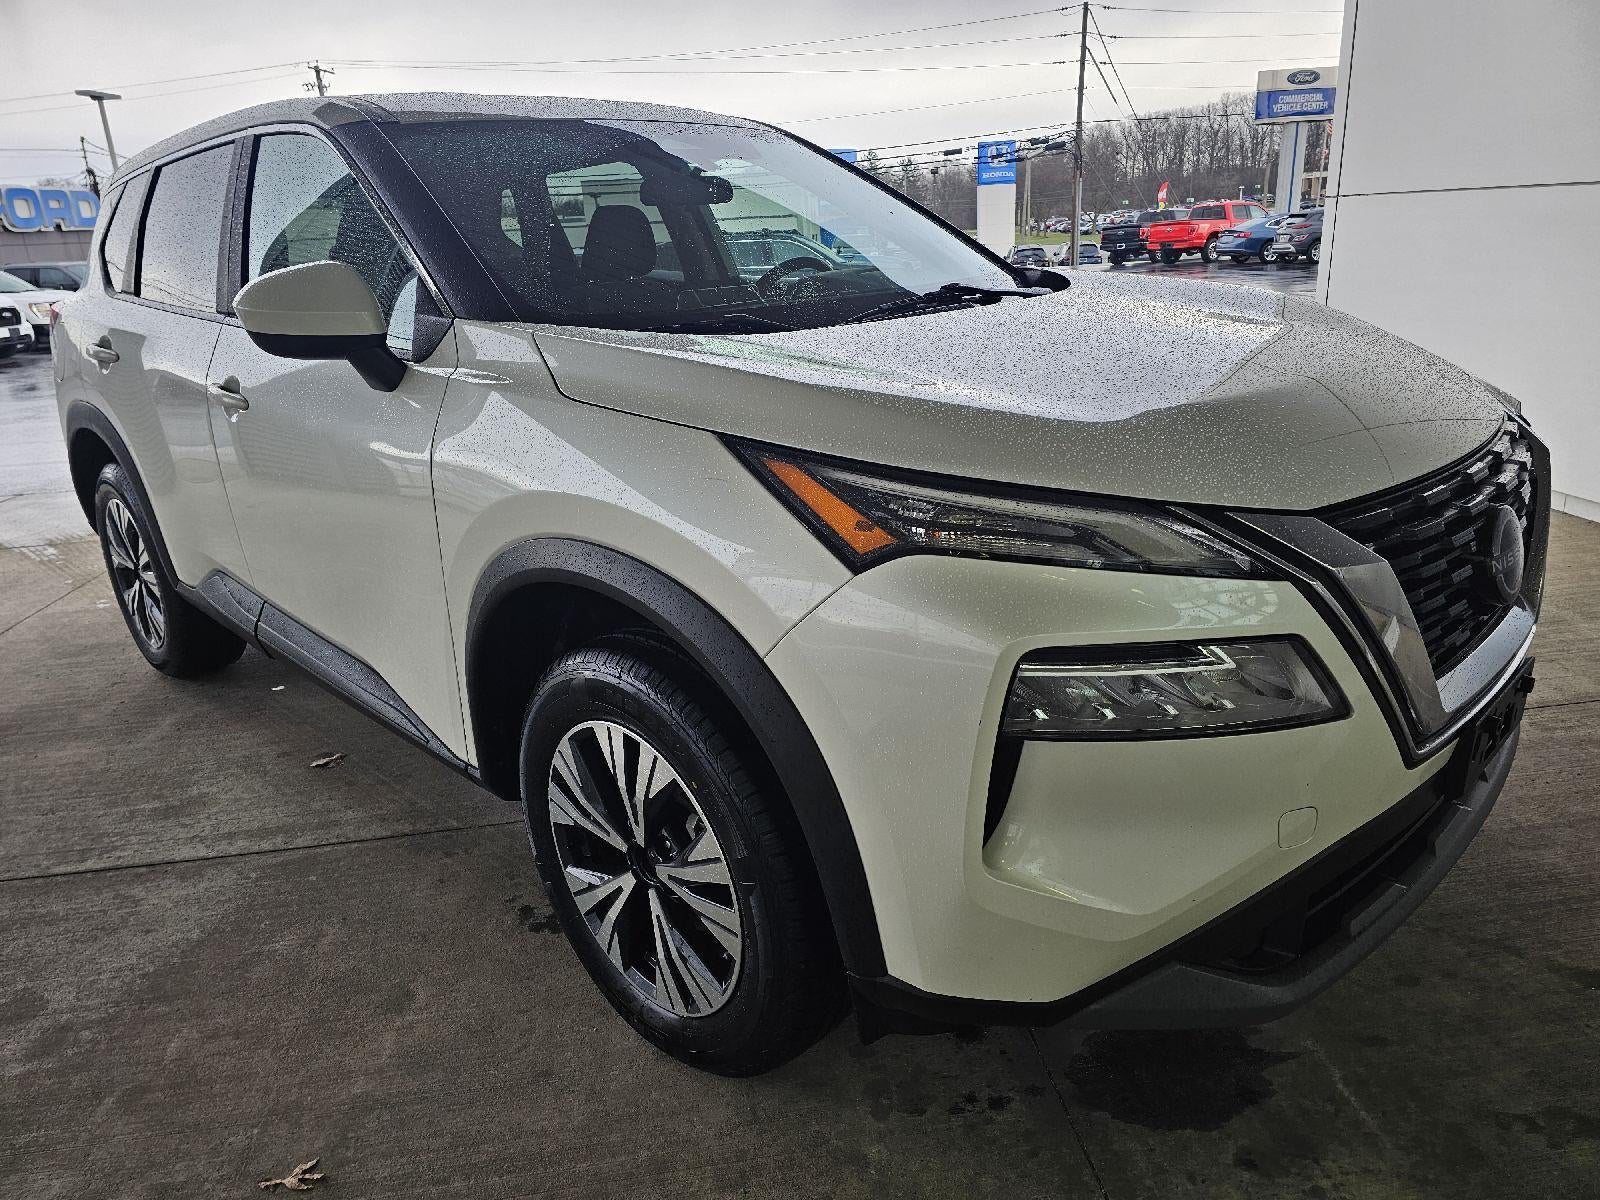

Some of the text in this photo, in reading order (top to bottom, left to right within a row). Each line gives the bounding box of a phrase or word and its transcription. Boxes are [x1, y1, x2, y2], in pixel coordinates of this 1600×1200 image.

[1295, 73, 1315, 83] Ford
[1279, 94, 1324, 103] COMMERCIAL
[1273, 101, 1328, 112] VEHICLE CENTER
[0, 187, 100, 230] ORD
